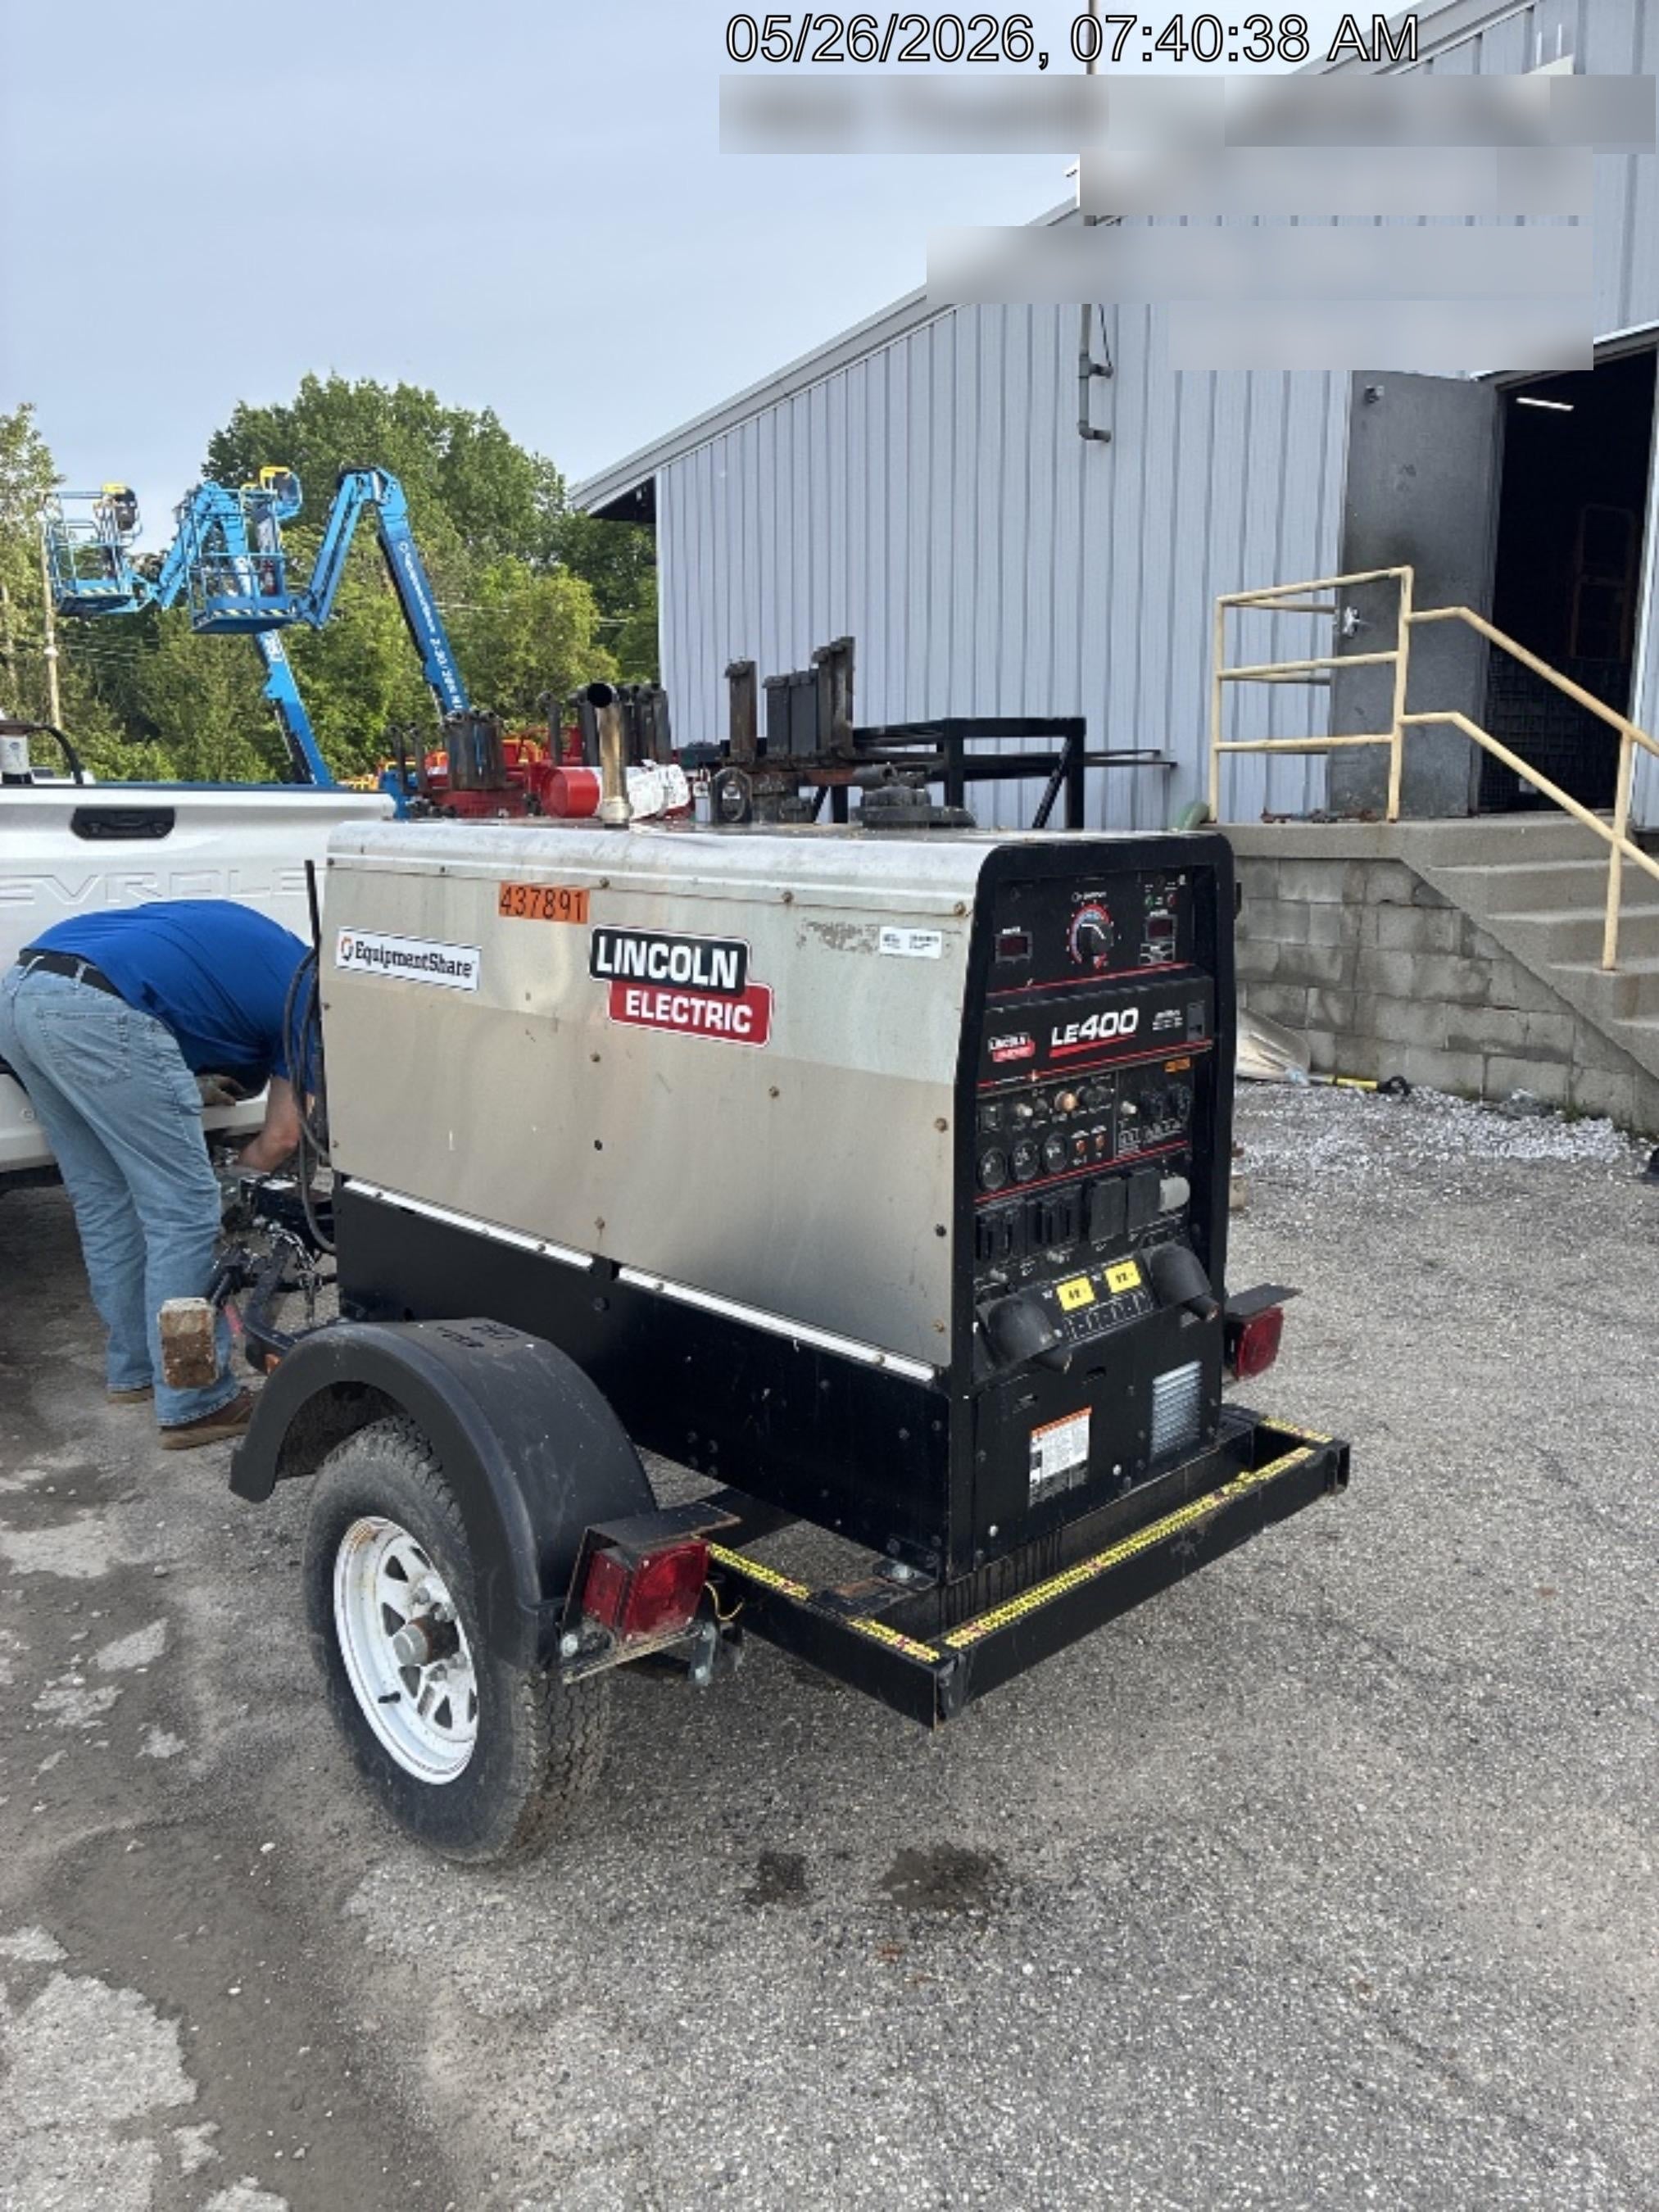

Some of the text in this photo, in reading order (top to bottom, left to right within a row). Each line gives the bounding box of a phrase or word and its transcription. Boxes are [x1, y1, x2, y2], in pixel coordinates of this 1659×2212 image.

[500, 886, 582, 922] 437891
[355, 941, 473, 979] EquipmentShare
[596, 936, 738, 989] LINCOLN
[625, 990, 753, 1034] ELECTRIC
[1051, 1007, 1139, 1046] LE400
